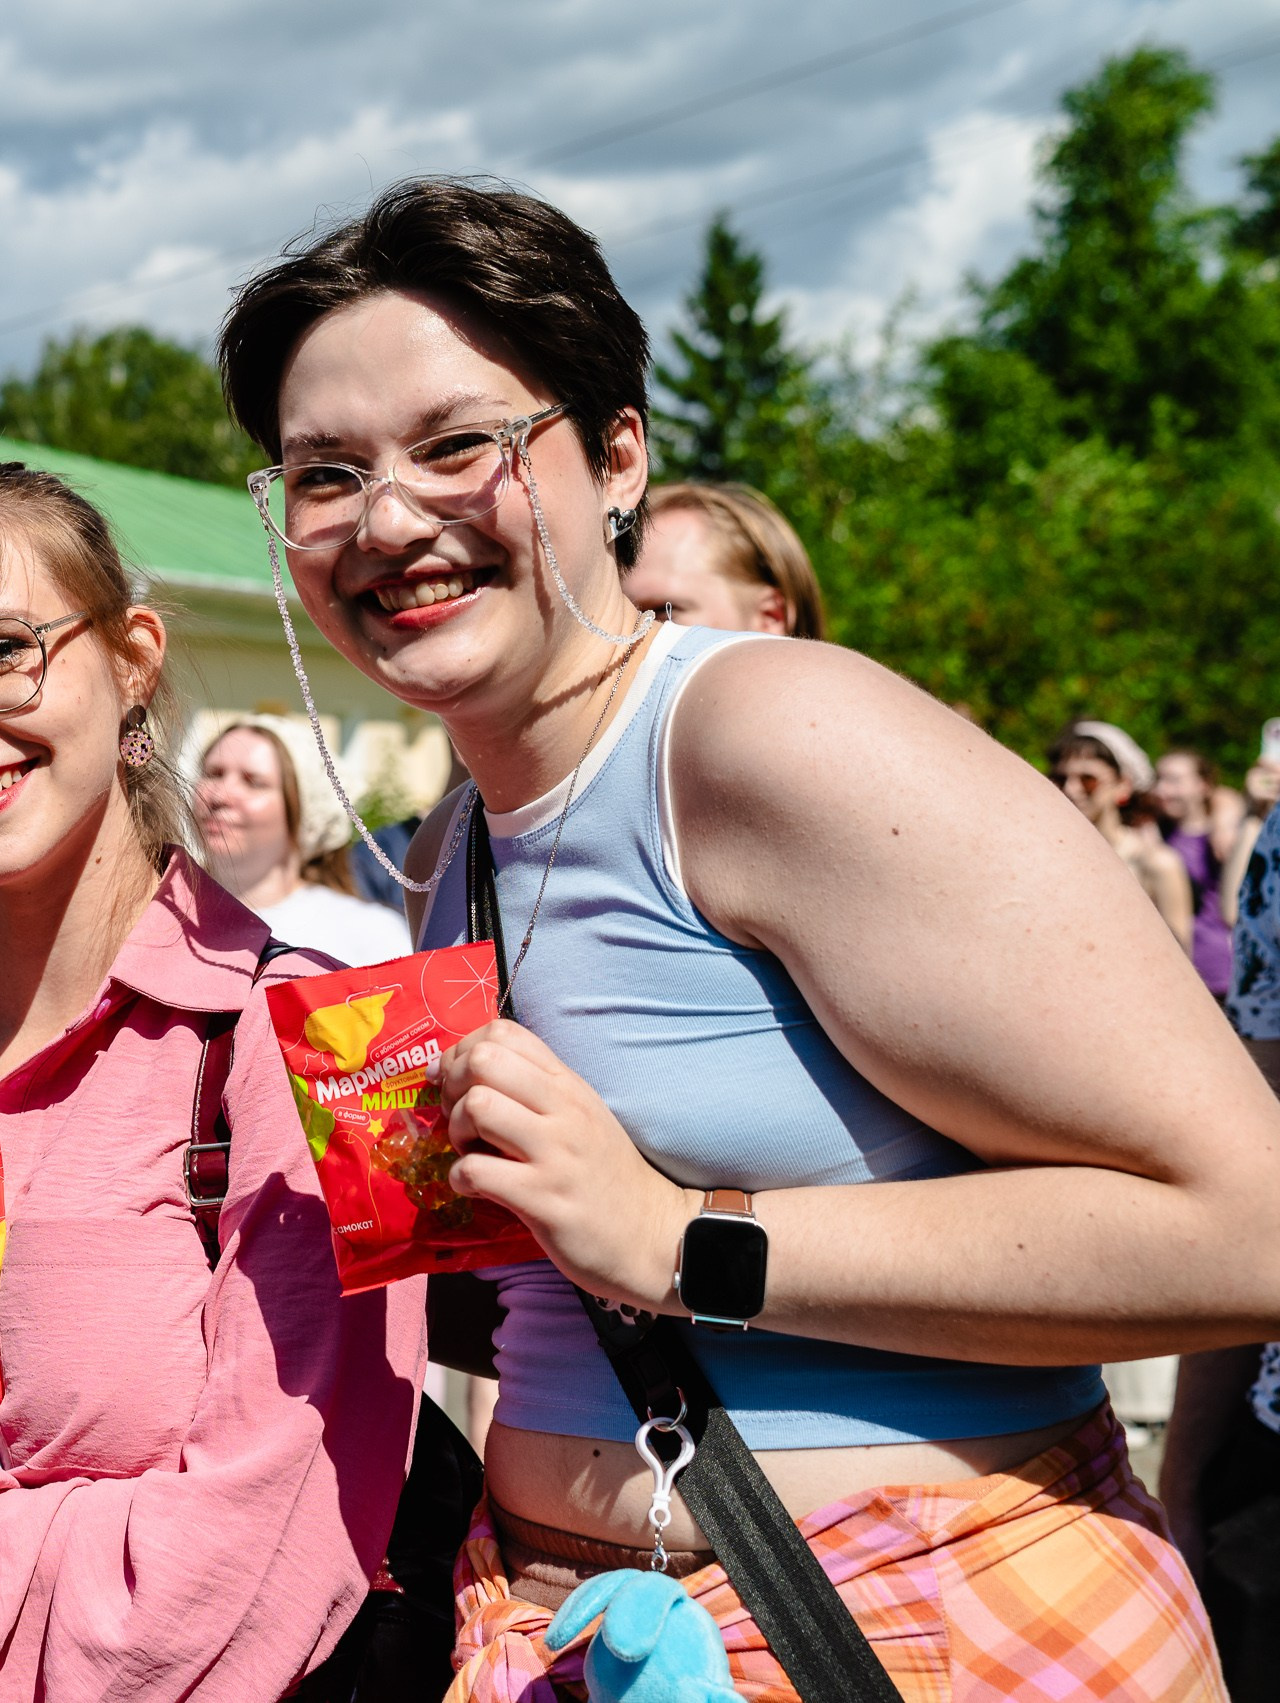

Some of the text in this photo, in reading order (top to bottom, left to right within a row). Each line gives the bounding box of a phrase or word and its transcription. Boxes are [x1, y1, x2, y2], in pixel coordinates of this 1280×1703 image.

[380, 1033, 410, 1055] яблочным
[410, 1021, 430, 1037] соком
[315, 1038, 443, 1105] Мармелад
[385, 1071, 419, 1090] фруктовый
[343, 1109, 367, 1121] форме
